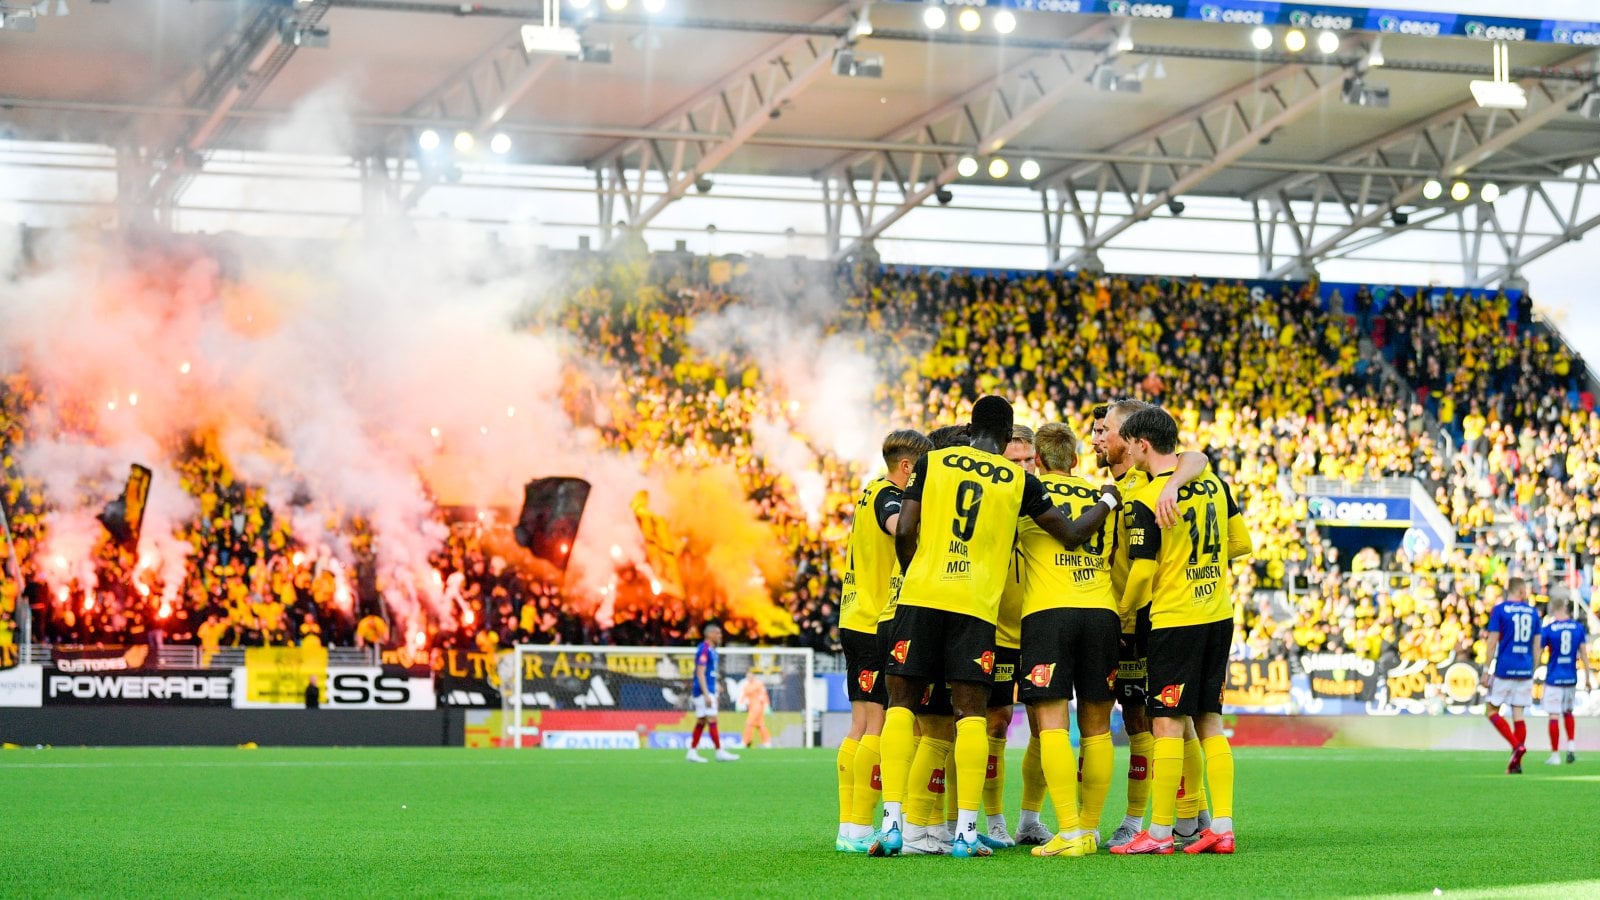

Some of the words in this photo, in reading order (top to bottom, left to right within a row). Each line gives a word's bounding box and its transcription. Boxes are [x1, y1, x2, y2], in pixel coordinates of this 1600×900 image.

[942, 454, 1014, 484] coop
[1177, 479, 1218, 503] oop
[952, 480, 983, 542] 9
[1182, 502, 1221, 565] 14
[946, 560, 971, 573] MOT
[1055, 553, 1082, 567] LEHNE
[1073, 568, 1095, 582] MOT
[1195, 581, 1217, 598] MOT
[1512, 613, 1532, 642] 18
[1560, 630, 1572, 655] 8
[49, 676, 230, 699] POWERADE
[1124, 685, 1133, 697] 5
